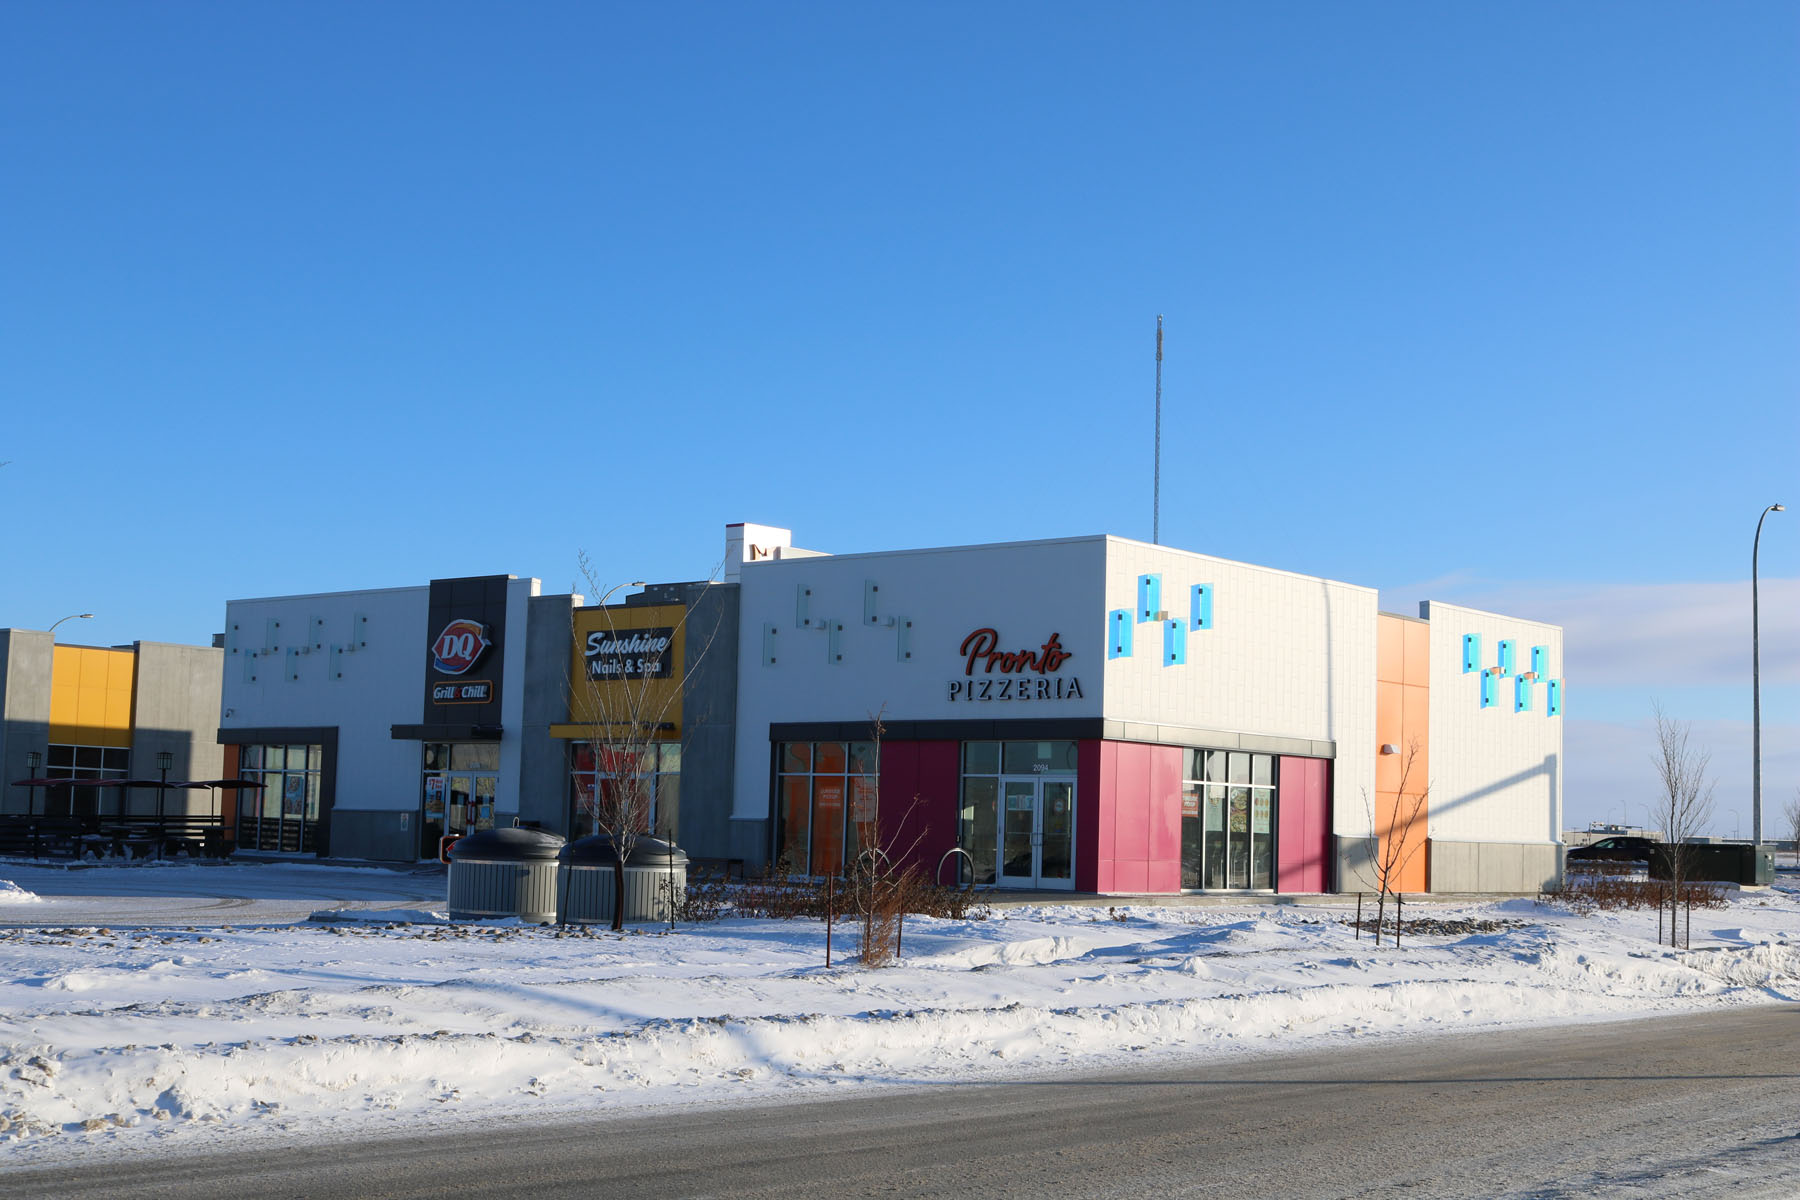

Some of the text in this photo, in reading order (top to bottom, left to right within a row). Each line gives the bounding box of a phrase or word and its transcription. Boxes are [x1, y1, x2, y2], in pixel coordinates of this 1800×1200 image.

[441, 633, 475, 660] DQ
[584, 632, 668, 656] Sunshine
[960, 628, 1072, 675] Pronto
[592, 658, 661, 674] Nails & Spa
[433, 686, 455, 699] Grill
[461, 685, 487, 698] Chill
[948, 677, 1083, 701] PIZZERIA
